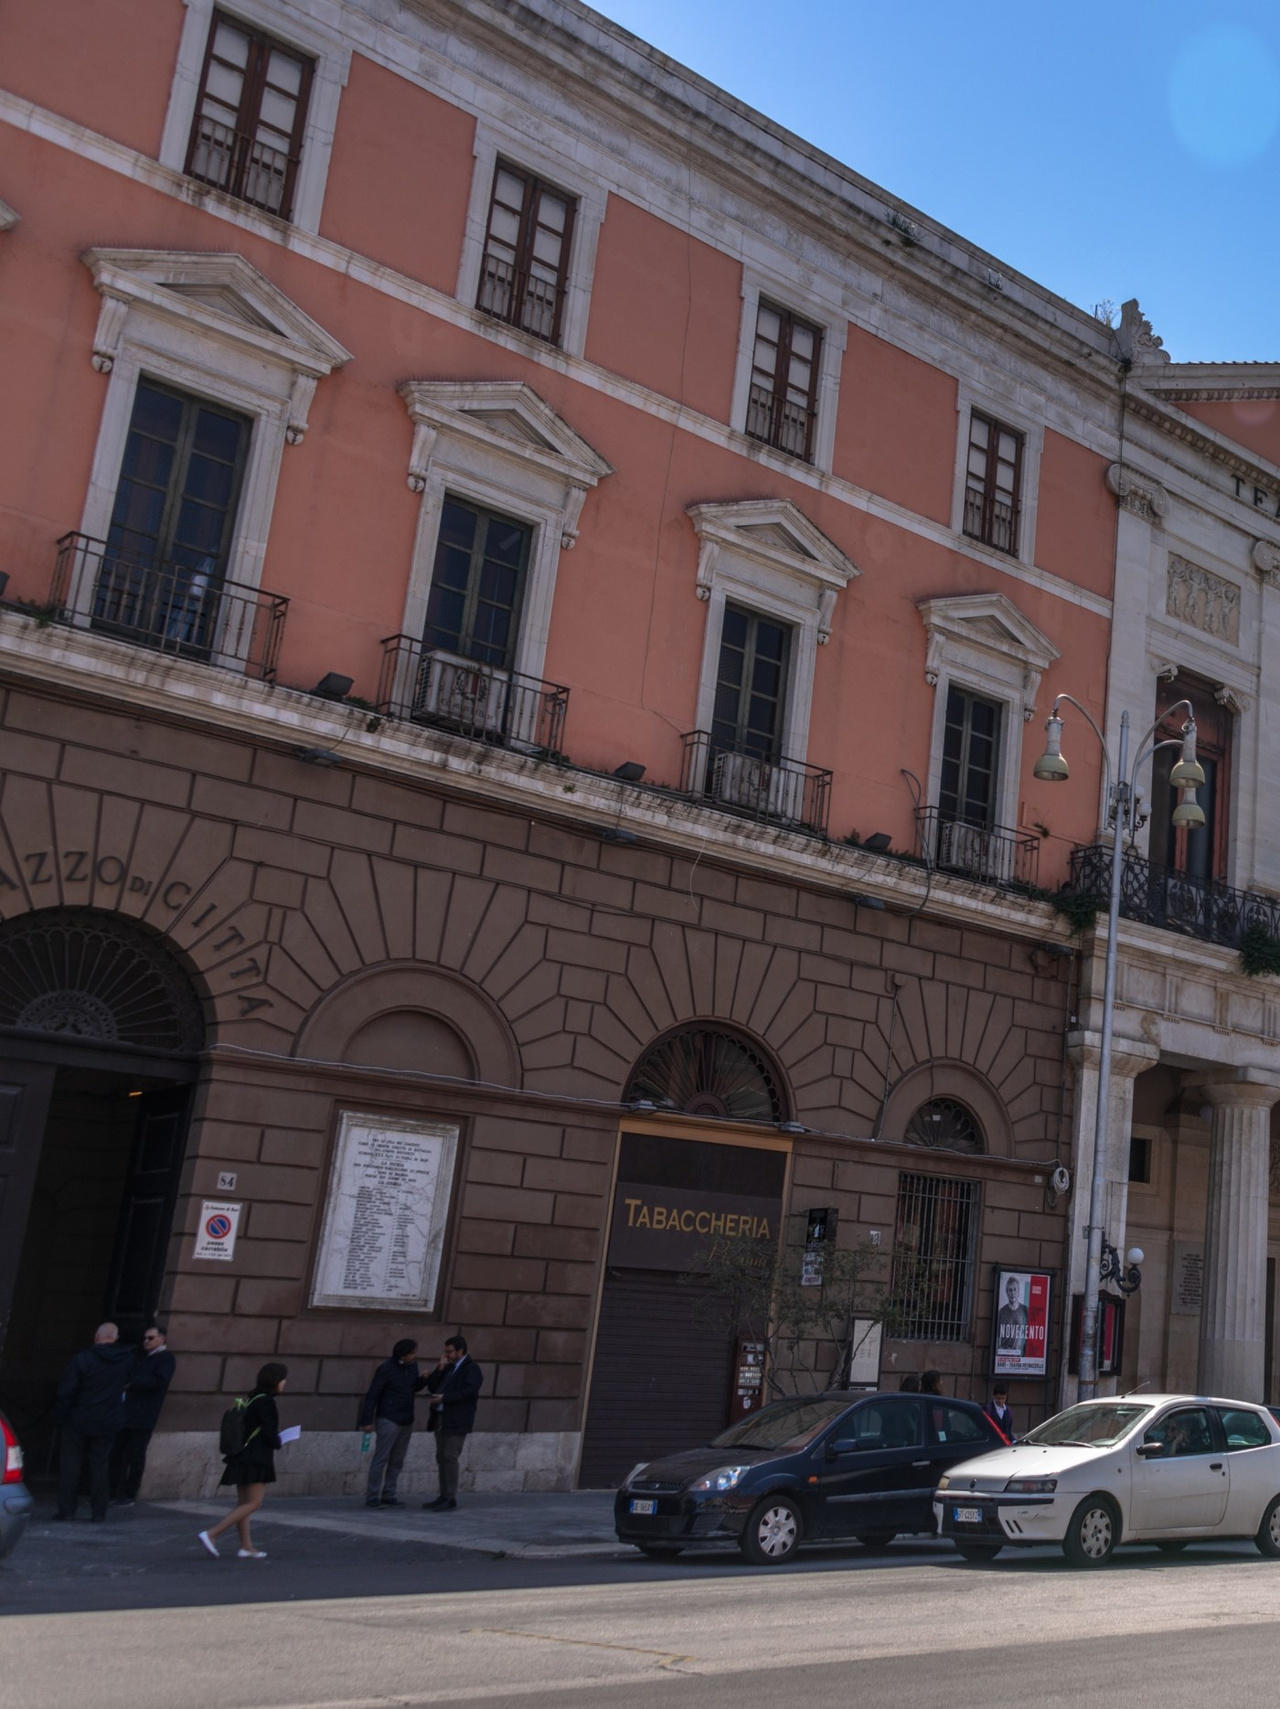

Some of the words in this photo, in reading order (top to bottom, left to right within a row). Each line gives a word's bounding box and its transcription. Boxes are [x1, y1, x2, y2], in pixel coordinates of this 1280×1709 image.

[129, 875, 152, 897] DI
[220, 1176, 235, 1187] 84
[625, 1198, 770, 1239] TABACCHERIA
[1000, 1323, 1044, 1340] NOVECENTO
